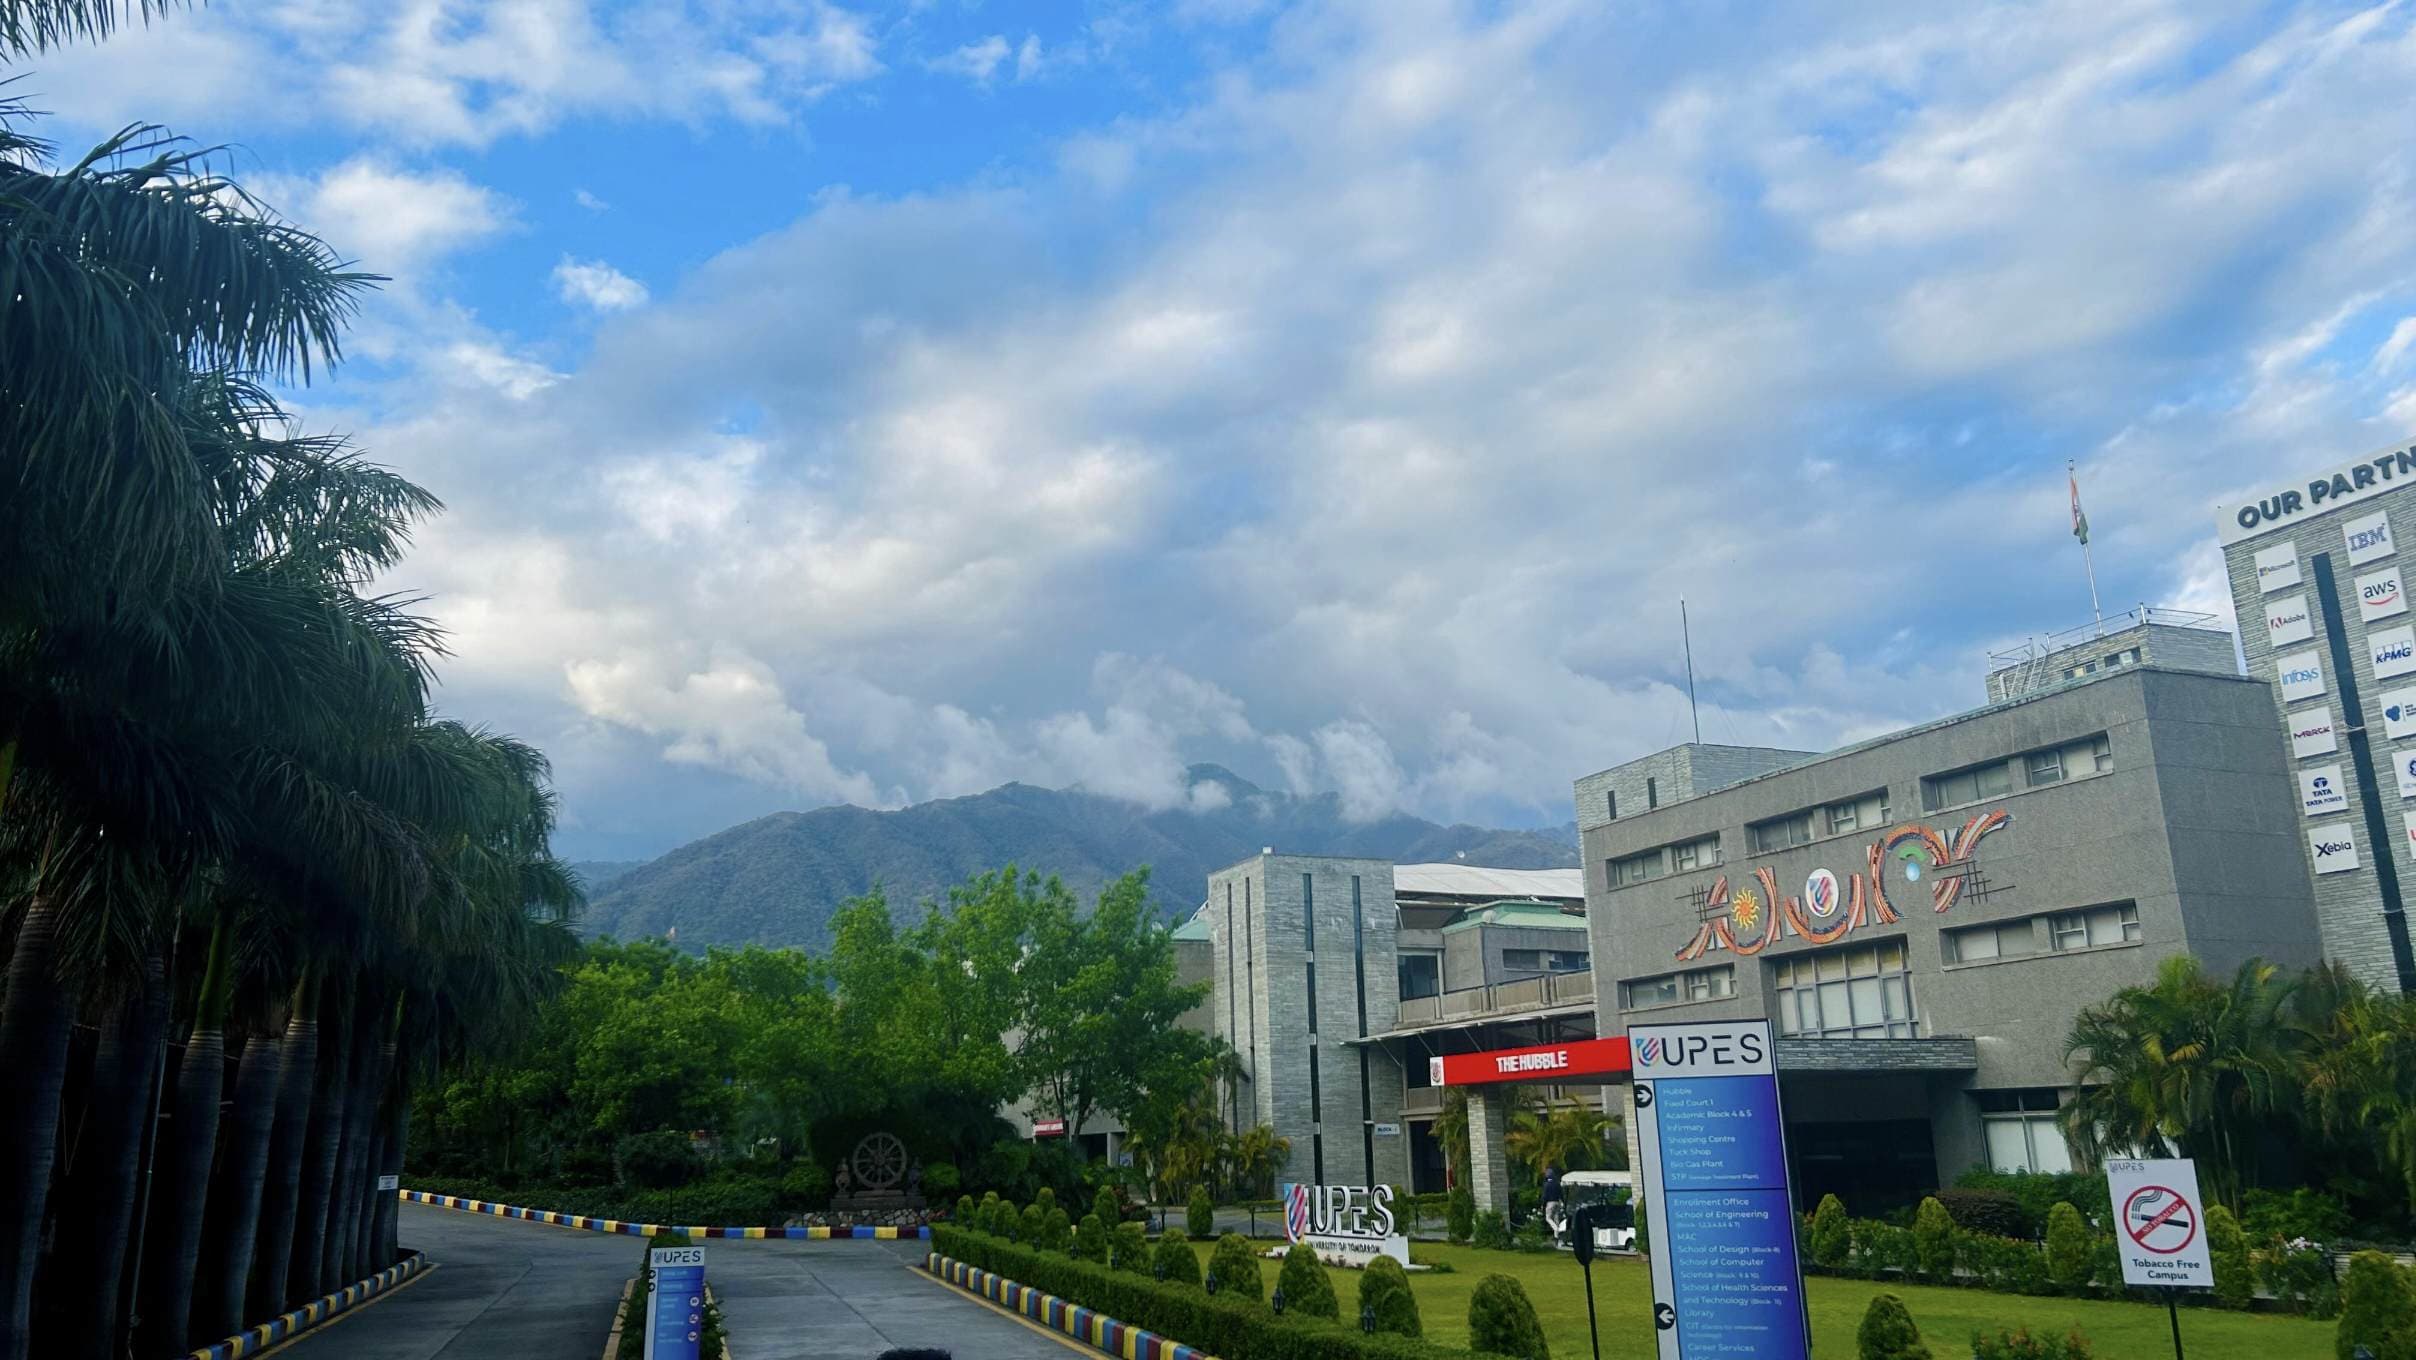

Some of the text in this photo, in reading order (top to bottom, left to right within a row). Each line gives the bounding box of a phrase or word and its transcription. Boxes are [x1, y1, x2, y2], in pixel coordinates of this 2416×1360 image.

[2237, 445, 2416, 529] OUR PARTN
[2348, 525, 2387, 551] IBM
[2363, 580, 2397, 598] aws
[2284, 614, 2306, 623] Adobe
[2376, 647, 2411, 664] KPMG
[2312, 789, 2332, 797] TATA
[2314, 842, 2352, 858] Xebia
[1661, 1034, 1763, 1066] UPES
[1496, 1051, 1568, 1072] THE HUBBLE
[1707, 1110, 1730, 1118] Block
[1746, 1109, 1752, 1117] 5
[1668, 1136, 1707, 1145] Shopping
[1690, 1148, 1712, 1156] Shop
[1685, 1160, 1700, 1168] Gas
[1702, 1160, 1724, 1168] Plant
[2118, 1162, 2144, 1172] UPES
[1722, 1198, 1749, 1206] Office
[1314, 1184, 1394, 1237] UPES
[1716, 1210, 1769, 1219] Engineering
[1677, 1232, 1696, 1240] MAC
[1719, 1245, 1749, 1254] Design
[664, 1250, 701, 1263] UPES
[1720, 1259, 1764, 1267] Computer
[2132, 1258, 2200, 1269] Tobacco Free
[1680, 1271, 1713, 1279] Science
[2148, 1270, 2189, 1281] Campus
[1682, 1284, 1709, 1292] School
[1711, 1284, 1719, 1292] of
[1751, 1284, 1788, 1292] Sciences
[1701, 1296, 1748, 1306] Technology
[1684, 1309, 1713, 1319] Library
[1687, 1343, 1755, 1352] Career Services
